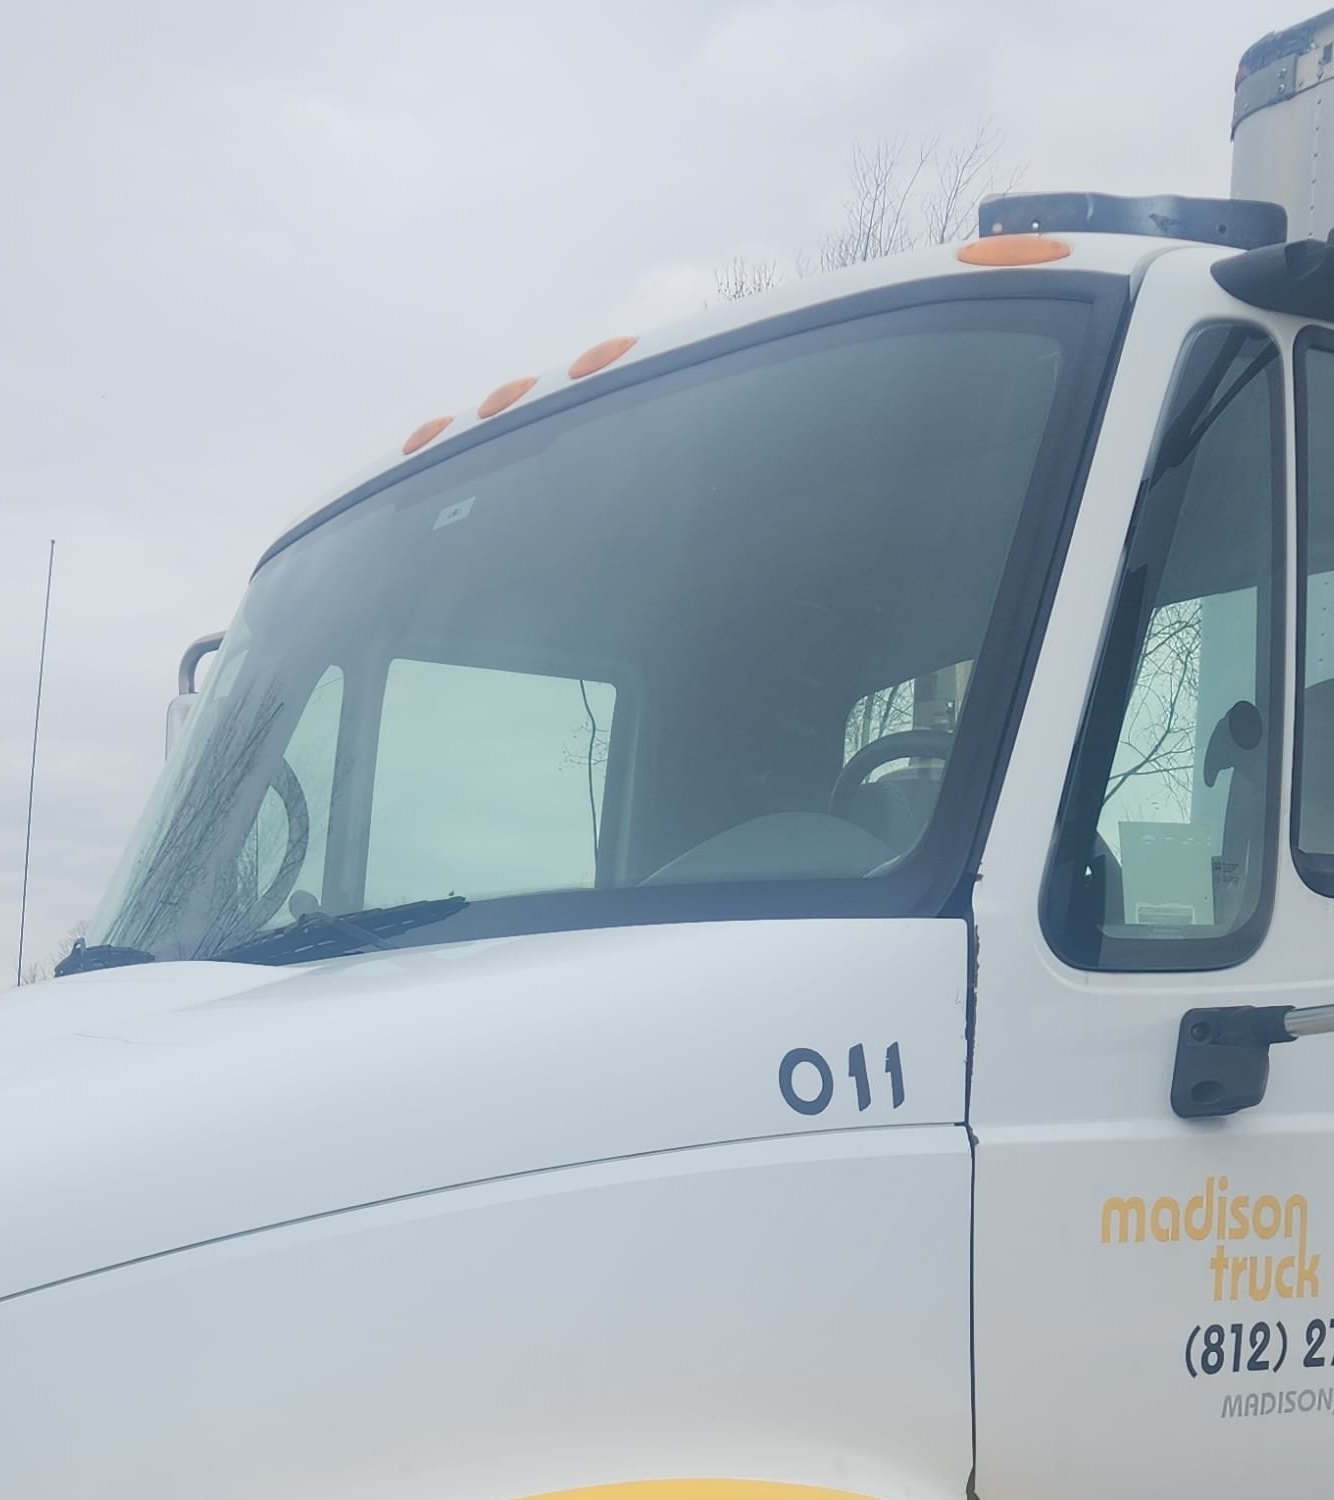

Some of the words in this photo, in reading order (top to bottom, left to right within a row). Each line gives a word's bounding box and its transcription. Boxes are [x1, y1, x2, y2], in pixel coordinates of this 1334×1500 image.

[1099, 1176, 1308, 1243] madison
[1210, 1243, 1320, 1301] truck
[1185, 1321, 1288, 1378] (812)
